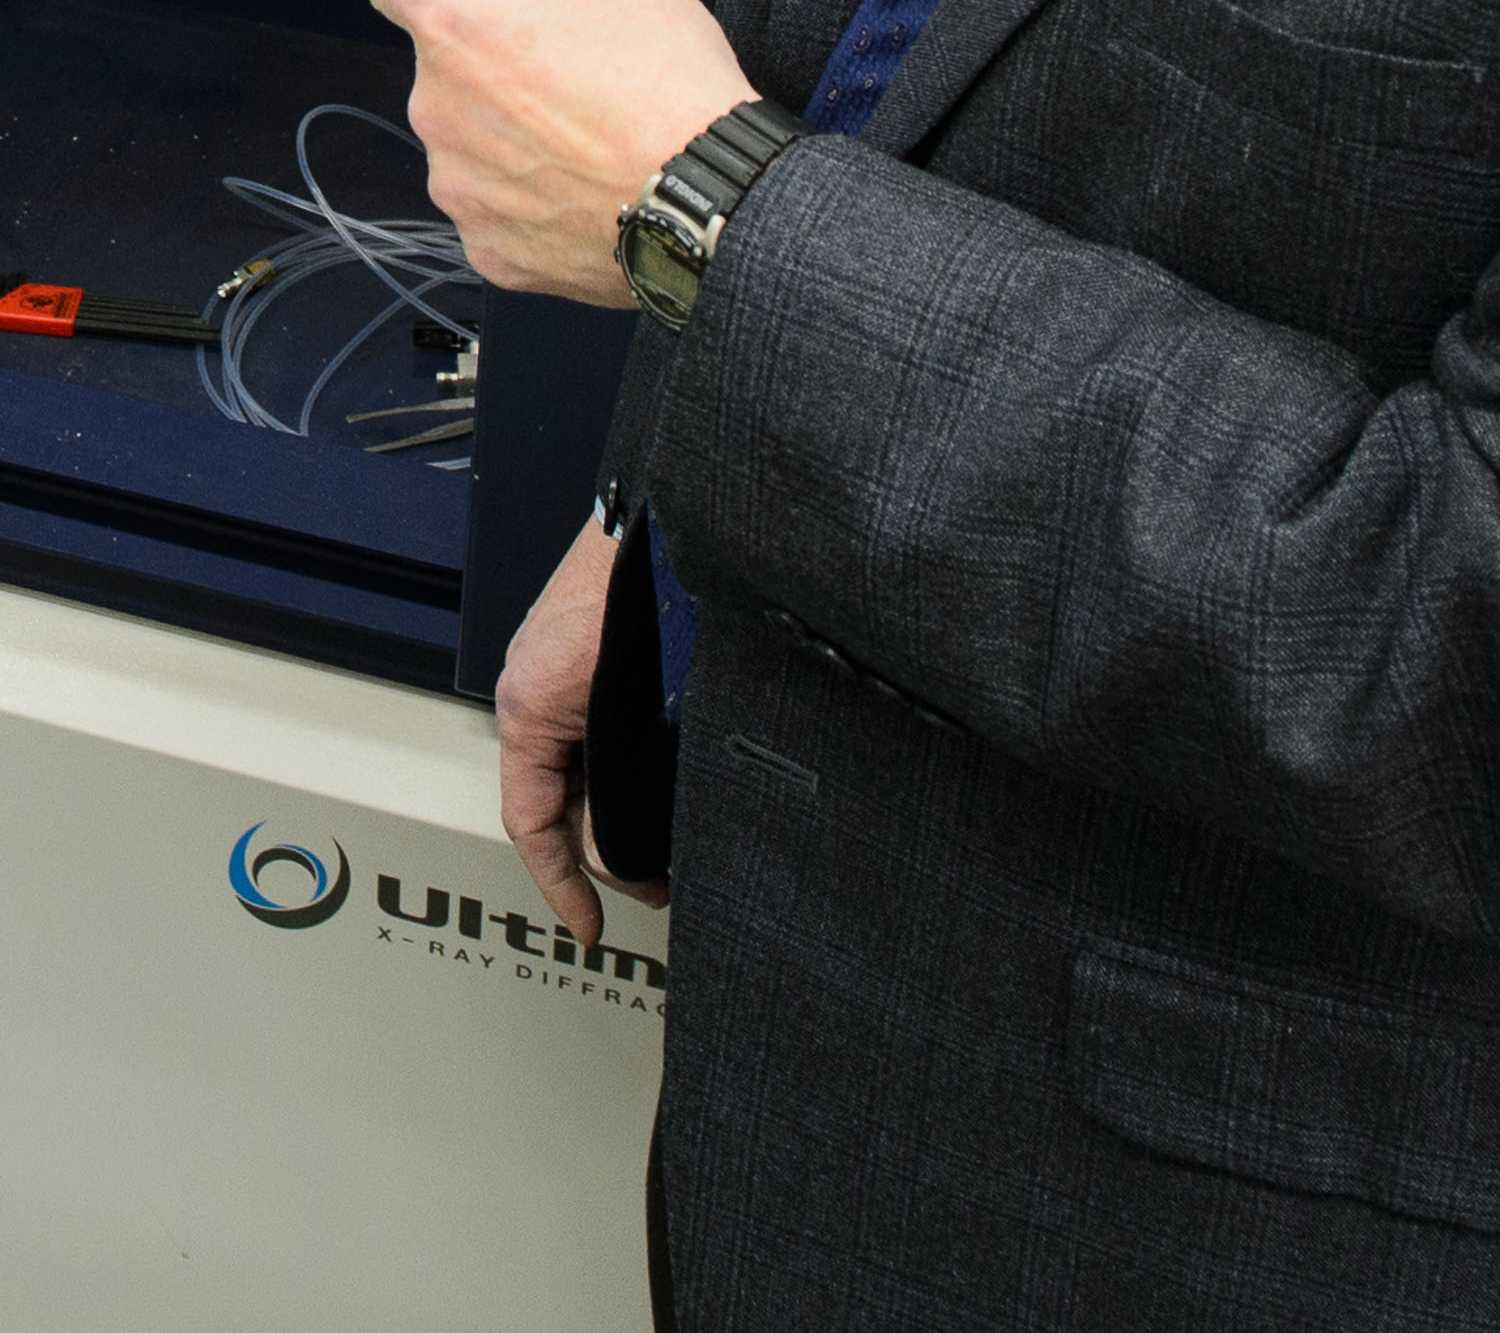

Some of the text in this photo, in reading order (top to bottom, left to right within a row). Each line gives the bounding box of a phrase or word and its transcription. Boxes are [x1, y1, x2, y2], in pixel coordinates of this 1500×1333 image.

[376, 873, 666, 991] Ultim
[377, 925, 666, 1018] X-RAY DIFFRAC
